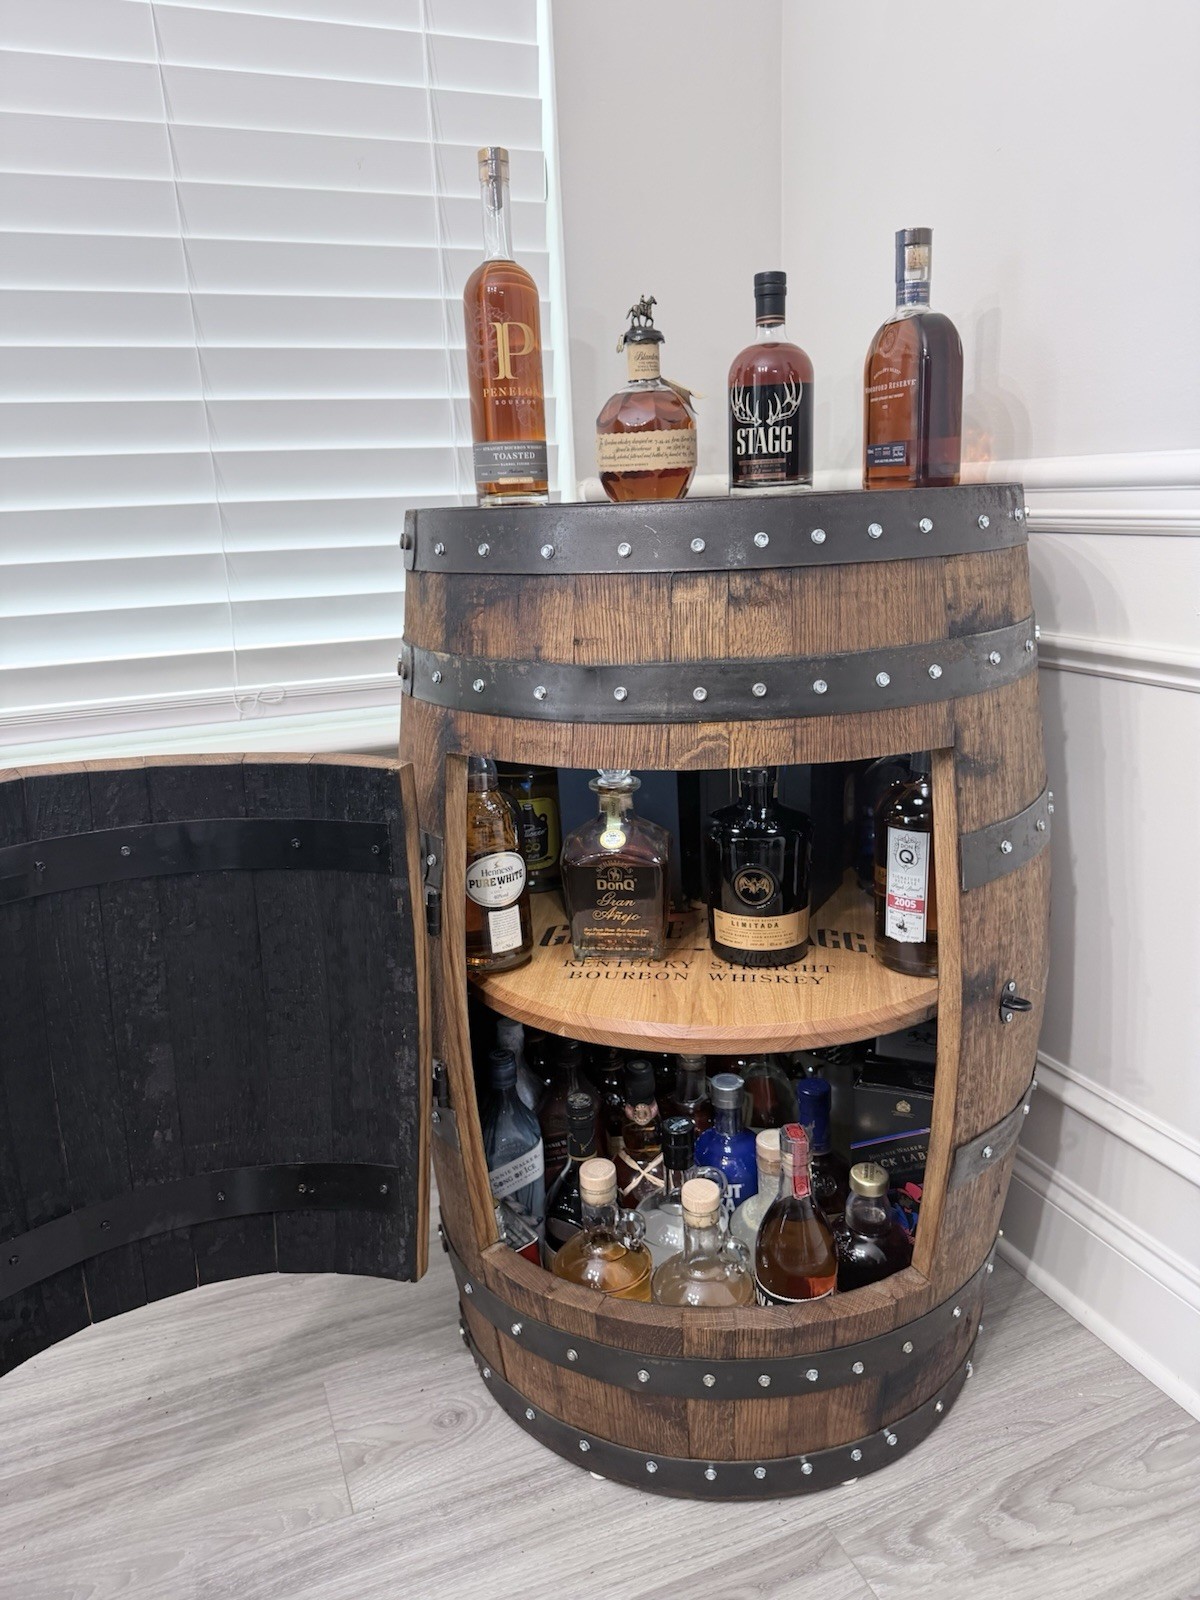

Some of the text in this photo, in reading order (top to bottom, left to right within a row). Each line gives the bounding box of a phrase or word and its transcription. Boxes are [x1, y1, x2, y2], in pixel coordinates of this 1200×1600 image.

[489, 321, 535, 380] P
[736, 425, 793, 456] STAGG
[493, 451, 536, 460] TOASTED
[899, 849, 915, 865] Q
[481, 864, 514, 877] Hennessy
[468, 868, 523, 889] PURE WHITE
[596, 878, 635, 892] DonQ
[596, 891, 636, 907] Gran
[894, 897, 917, 909] 2005
[592, 906, 642, 926] Añejo
[731, 920, 780, 929] LIMITADA
[562, 959, 694, 969] KENTUCKY
[569, 970, 825, 985] BOURBON WHISKEY
[493, 1163, 537, 1190] SONG OF ICE
